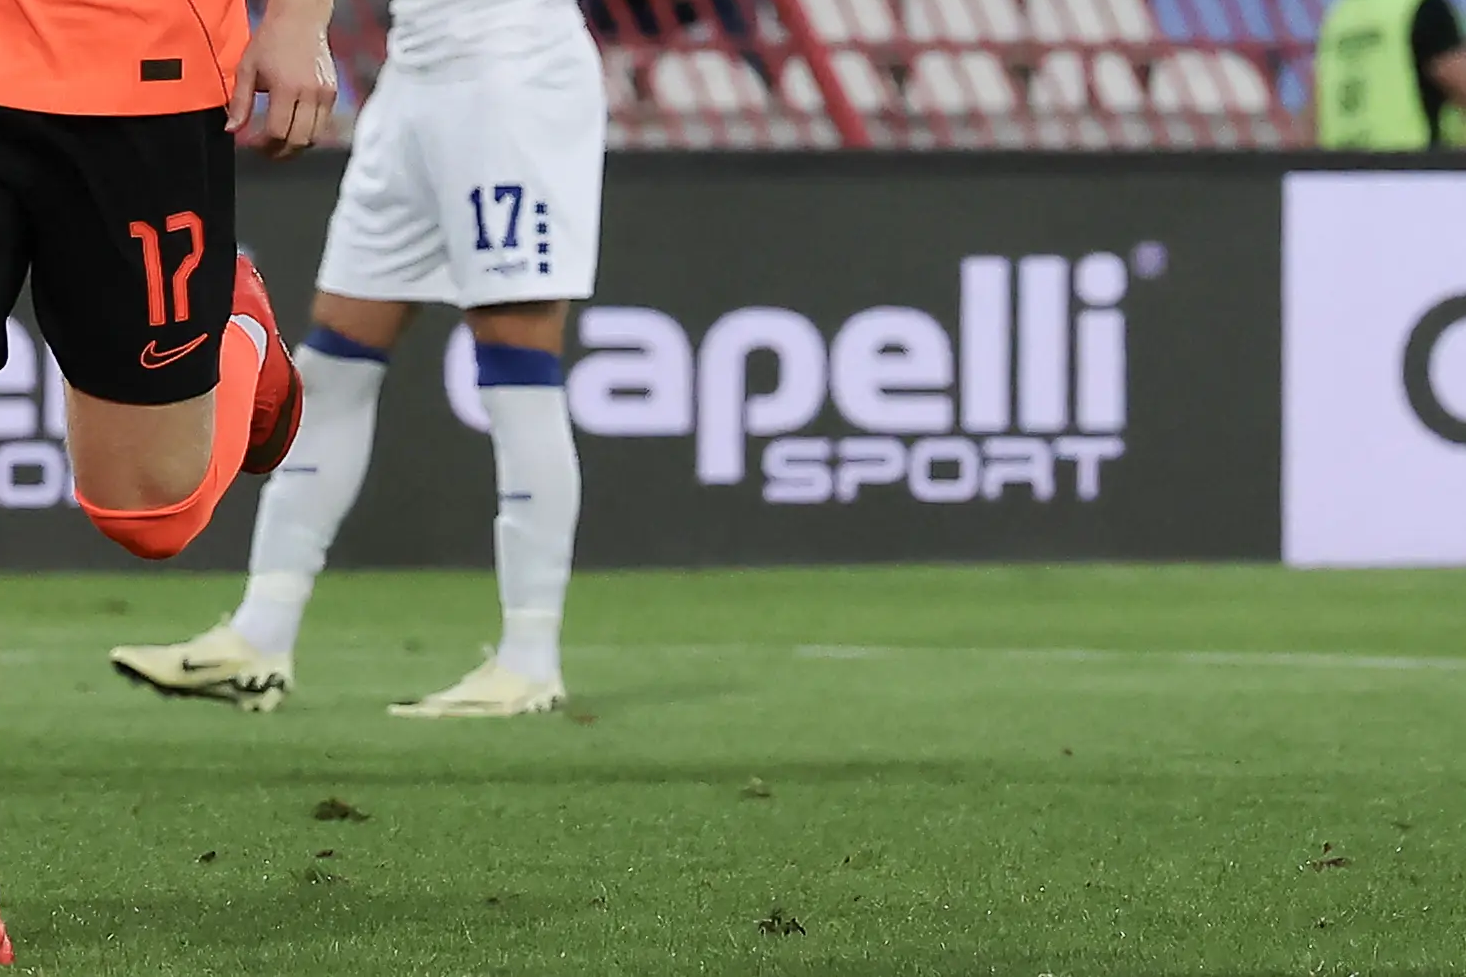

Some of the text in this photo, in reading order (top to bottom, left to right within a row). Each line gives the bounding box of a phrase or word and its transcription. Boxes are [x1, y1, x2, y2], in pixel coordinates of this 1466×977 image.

[469, 186, 523, 250] 17
[129, 210, 205, 326] 17
[762, 436, 1126, 503] SPORT
